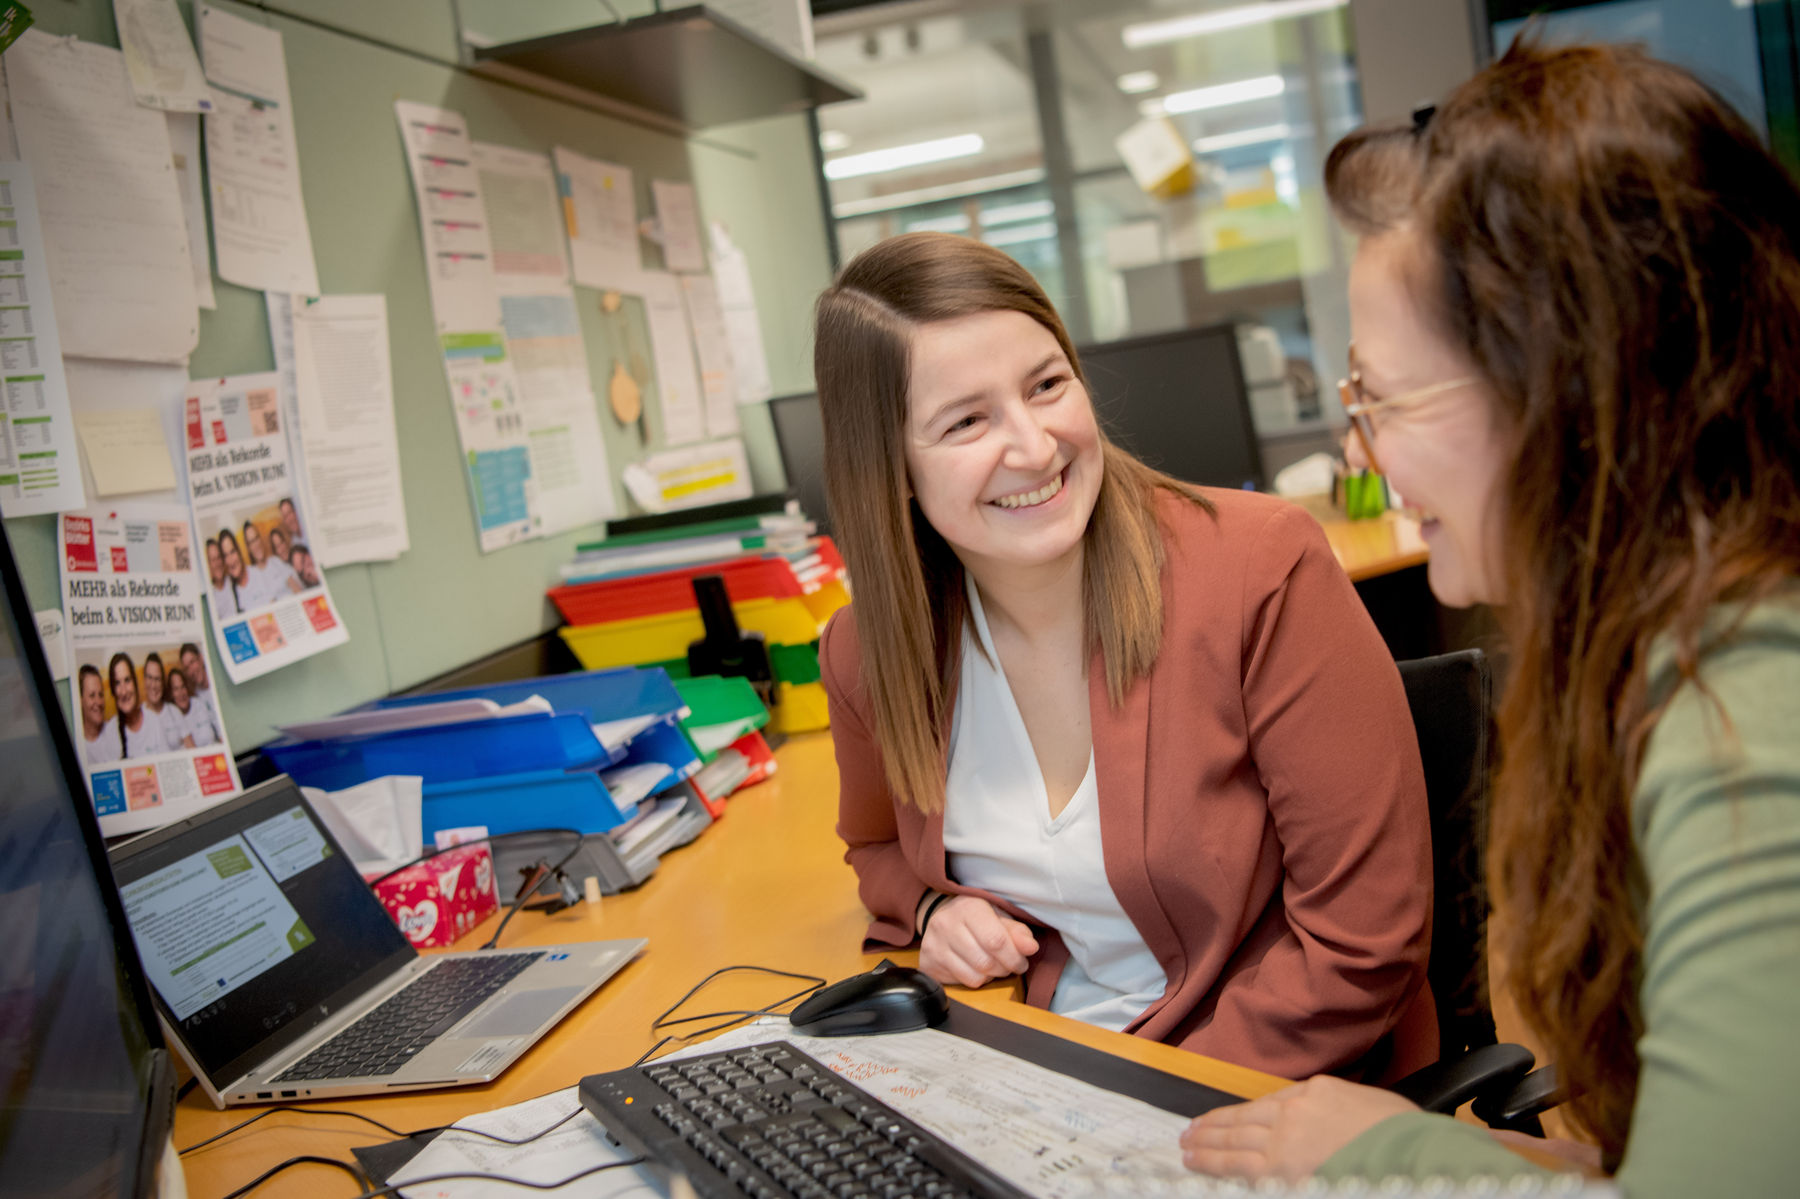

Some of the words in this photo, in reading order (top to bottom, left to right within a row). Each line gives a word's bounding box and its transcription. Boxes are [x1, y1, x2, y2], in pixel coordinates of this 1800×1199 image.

[69, 580, 108, 598] MEHR
[110, 579, 127, 598] als
[128, 579, 180, 598] Rekorde
[71, 606, 104, 625] beim
[106, 606, 118, 623] 8.
[119, 606, 162, 623] VISION
[164, 603, 196, 621] RUN!
